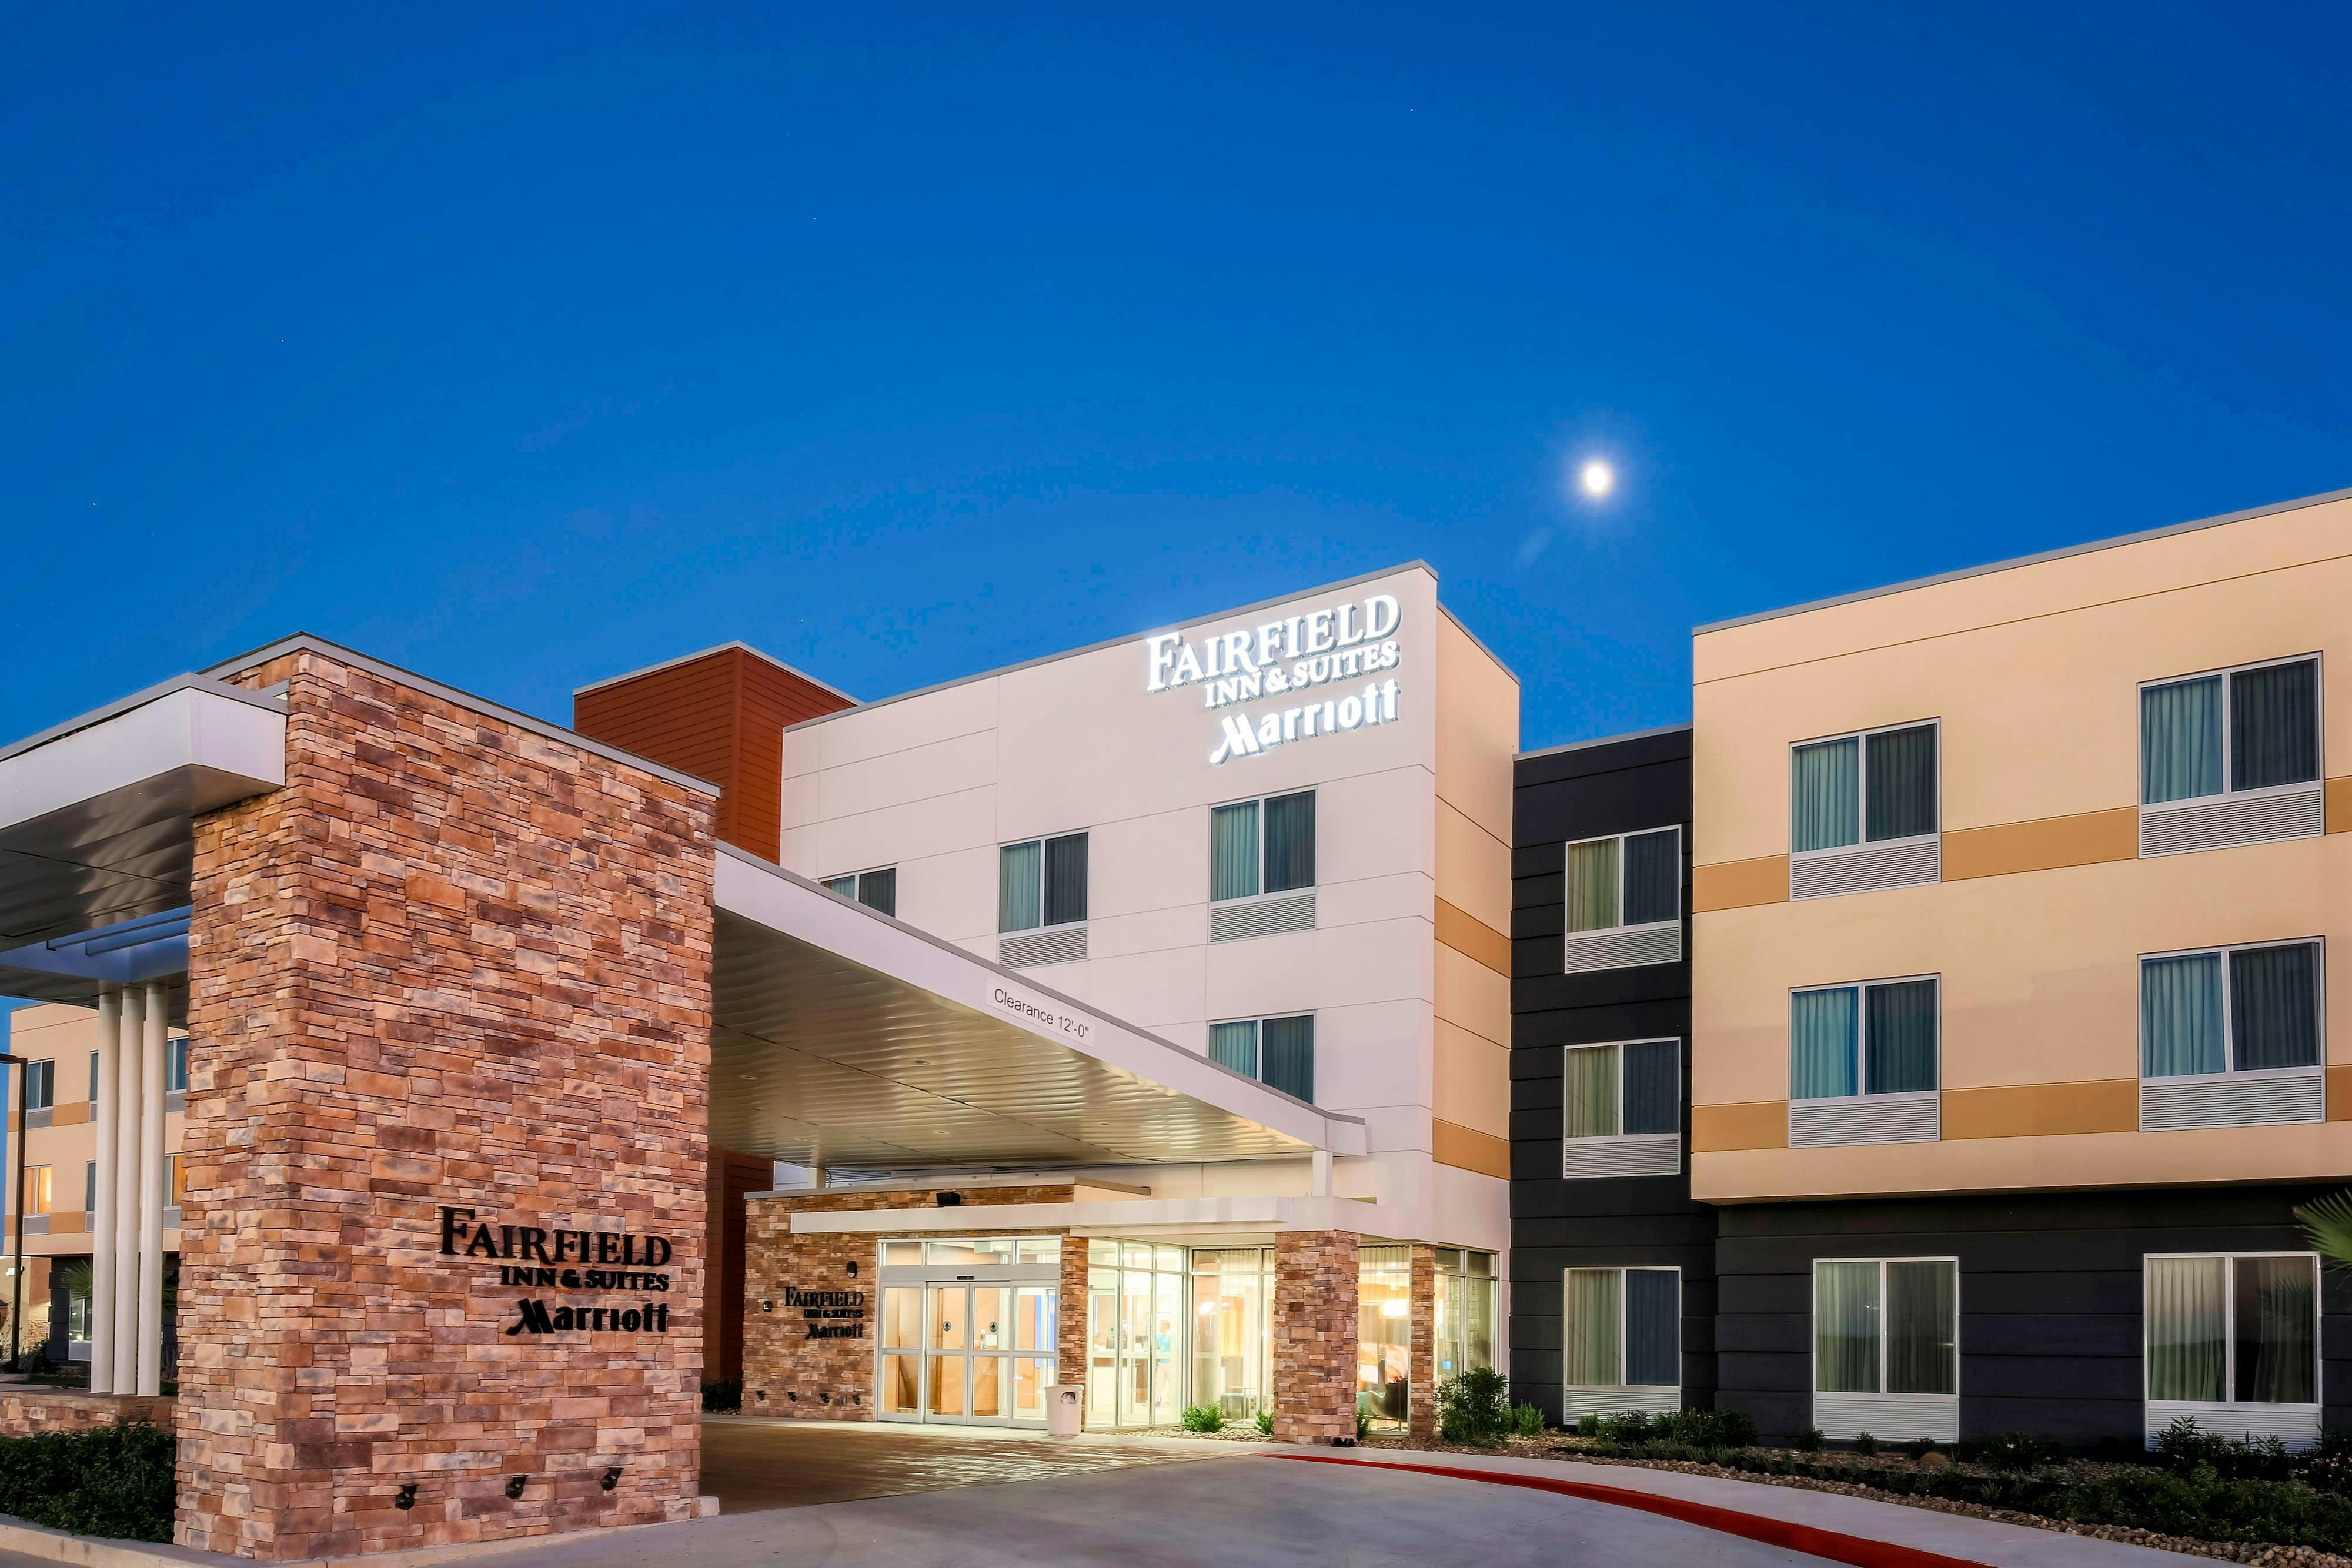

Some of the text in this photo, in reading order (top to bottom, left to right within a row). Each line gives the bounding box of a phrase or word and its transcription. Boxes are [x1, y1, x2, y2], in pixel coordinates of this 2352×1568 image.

[1146, 594, 1401, 693] FAIRFIELD
[1209, 678, 1401, 765] Marriott
[994, 988, 1089, 1038] Clearance 12'-0"
[438, 1206, 672, 1266] FAIRFIELD
[585, 1269, 669, 1292] SUITES
[784, 1286, 864, 1308] FAIRFIELD
[505, 1298, 669, 1336] Marriott
[804, 1323, 864, 1340] Marriott
